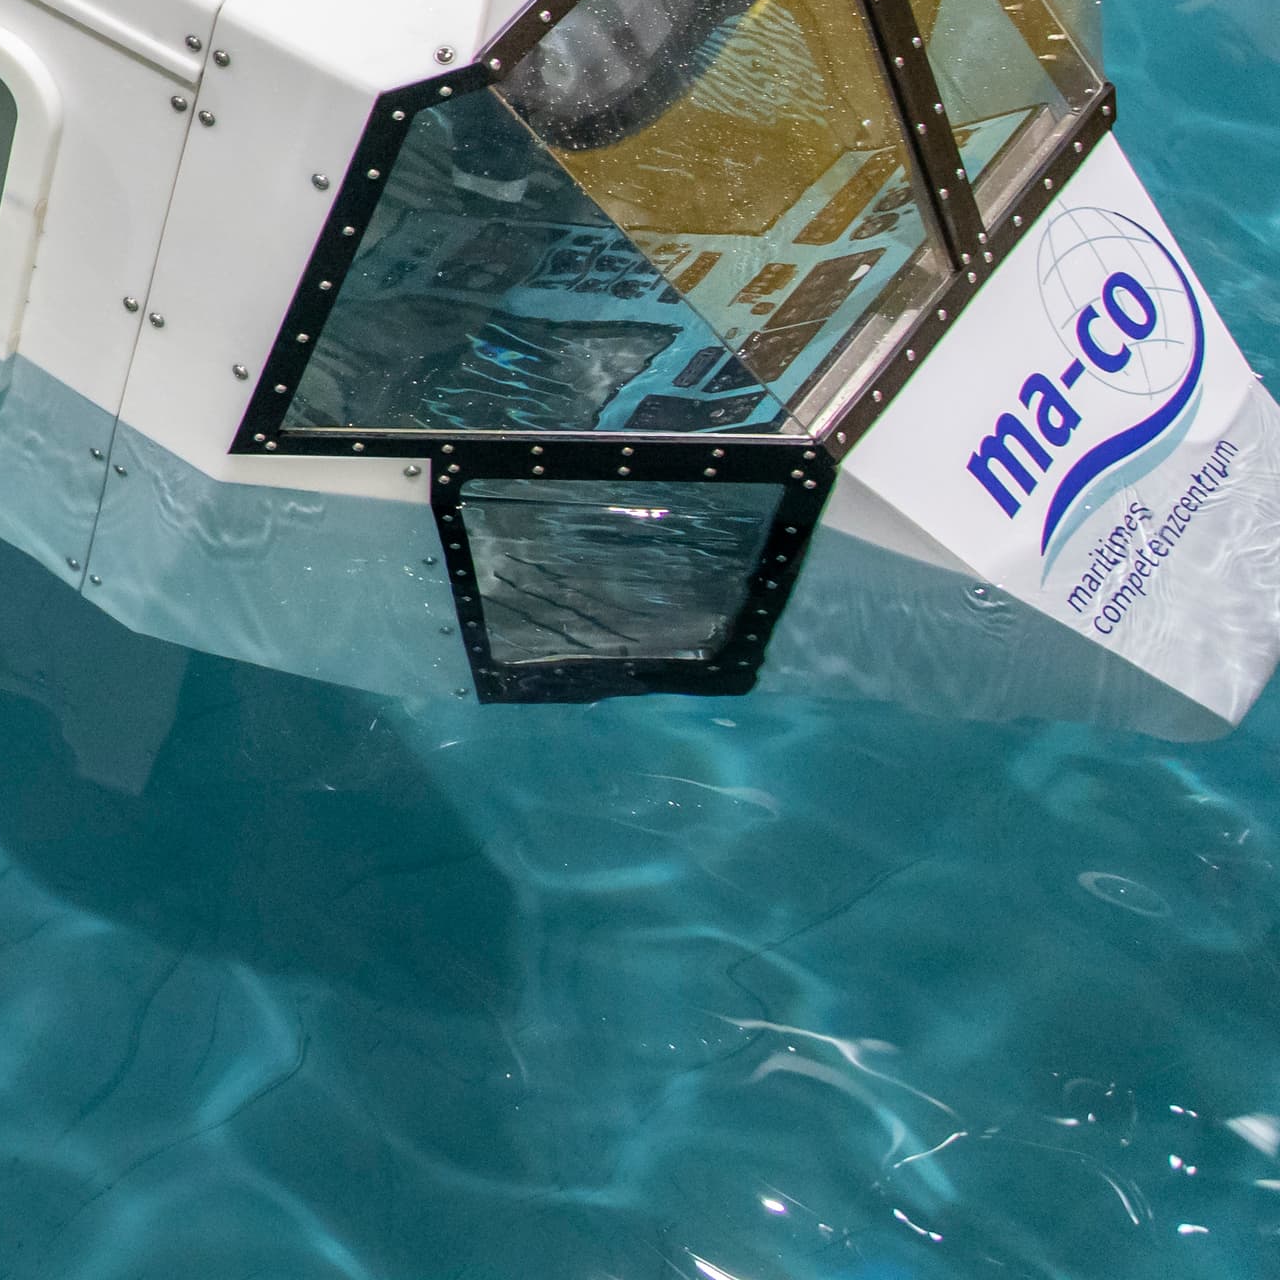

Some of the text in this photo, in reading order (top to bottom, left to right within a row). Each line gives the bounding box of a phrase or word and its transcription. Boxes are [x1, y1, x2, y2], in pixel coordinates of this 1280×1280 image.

[966, 271, 1158, 520] ma-co
[1066, 502, 1153, 613] maritimes
[1093, 440, 1239, 635] competenzcentrum
